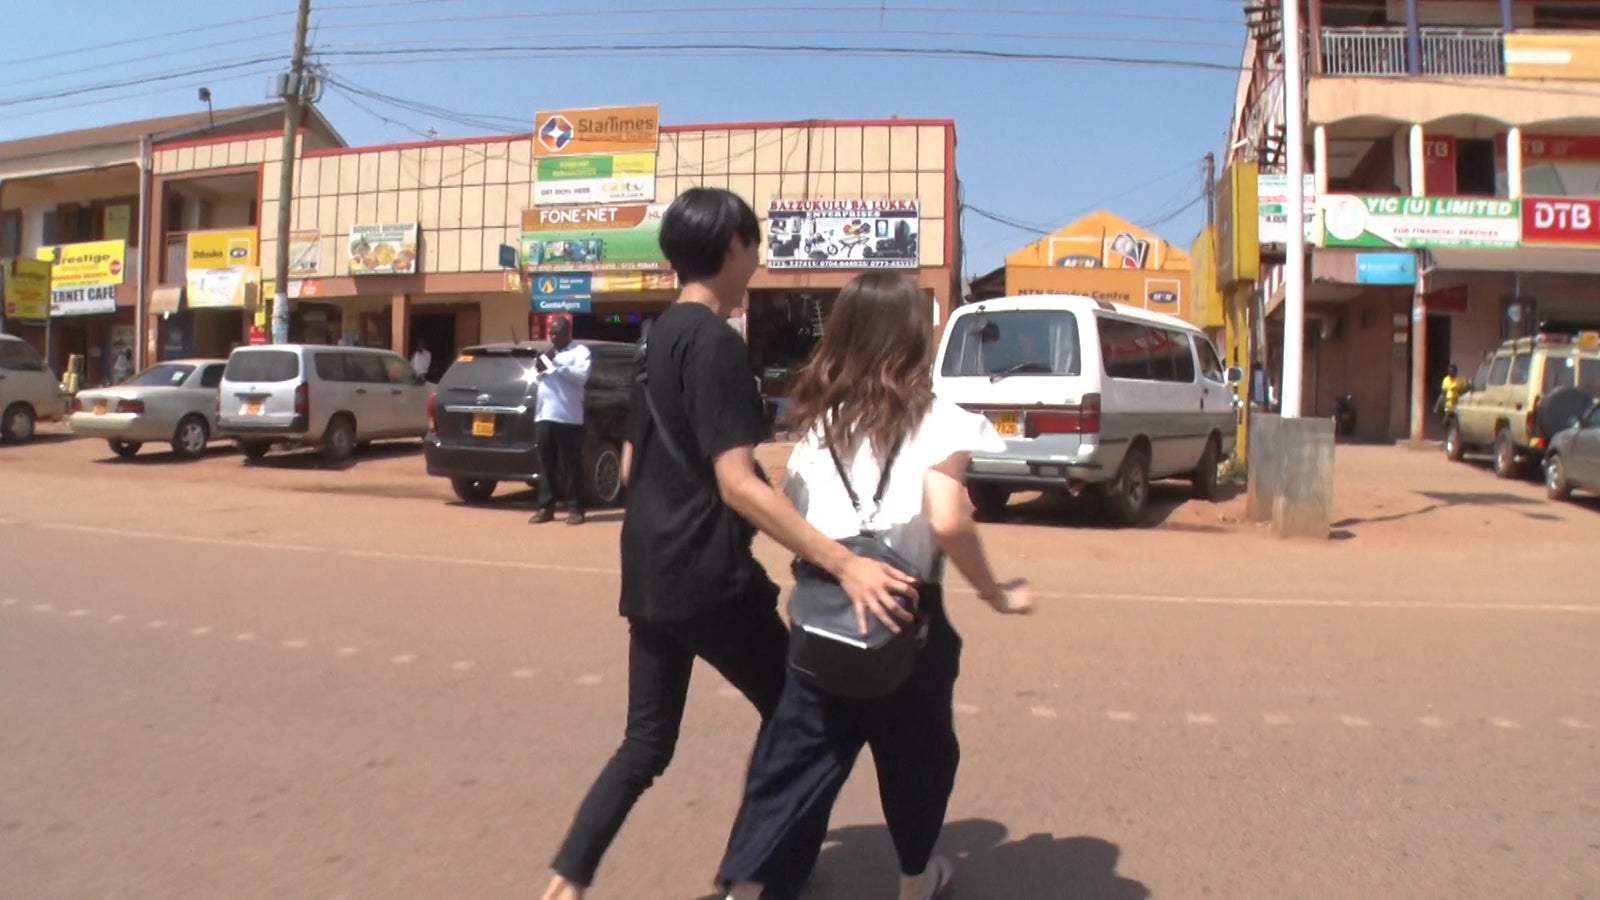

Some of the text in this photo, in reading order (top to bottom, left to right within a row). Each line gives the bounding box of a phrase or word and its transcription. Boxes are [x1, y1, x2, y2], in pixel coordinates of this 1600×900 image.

[578, 116, 654, 133] StarTimes
[771, 201, 917, 211] BAZZUKULU BA LUKKA
[1403, 198, 1430, 215] (U)
[1435, 198, 1511, 216] LIMITED
[540, 207, 619, 224] FONE-NET
[806, 211, 881, 219] ENTERPRISES
[1535, 203, 1592, 230] DTB
[1064, 259, 1096, 268] MTN
[1092, 290, 1130, 301] Centre
[1152, 293, 1173, 301] MTN
